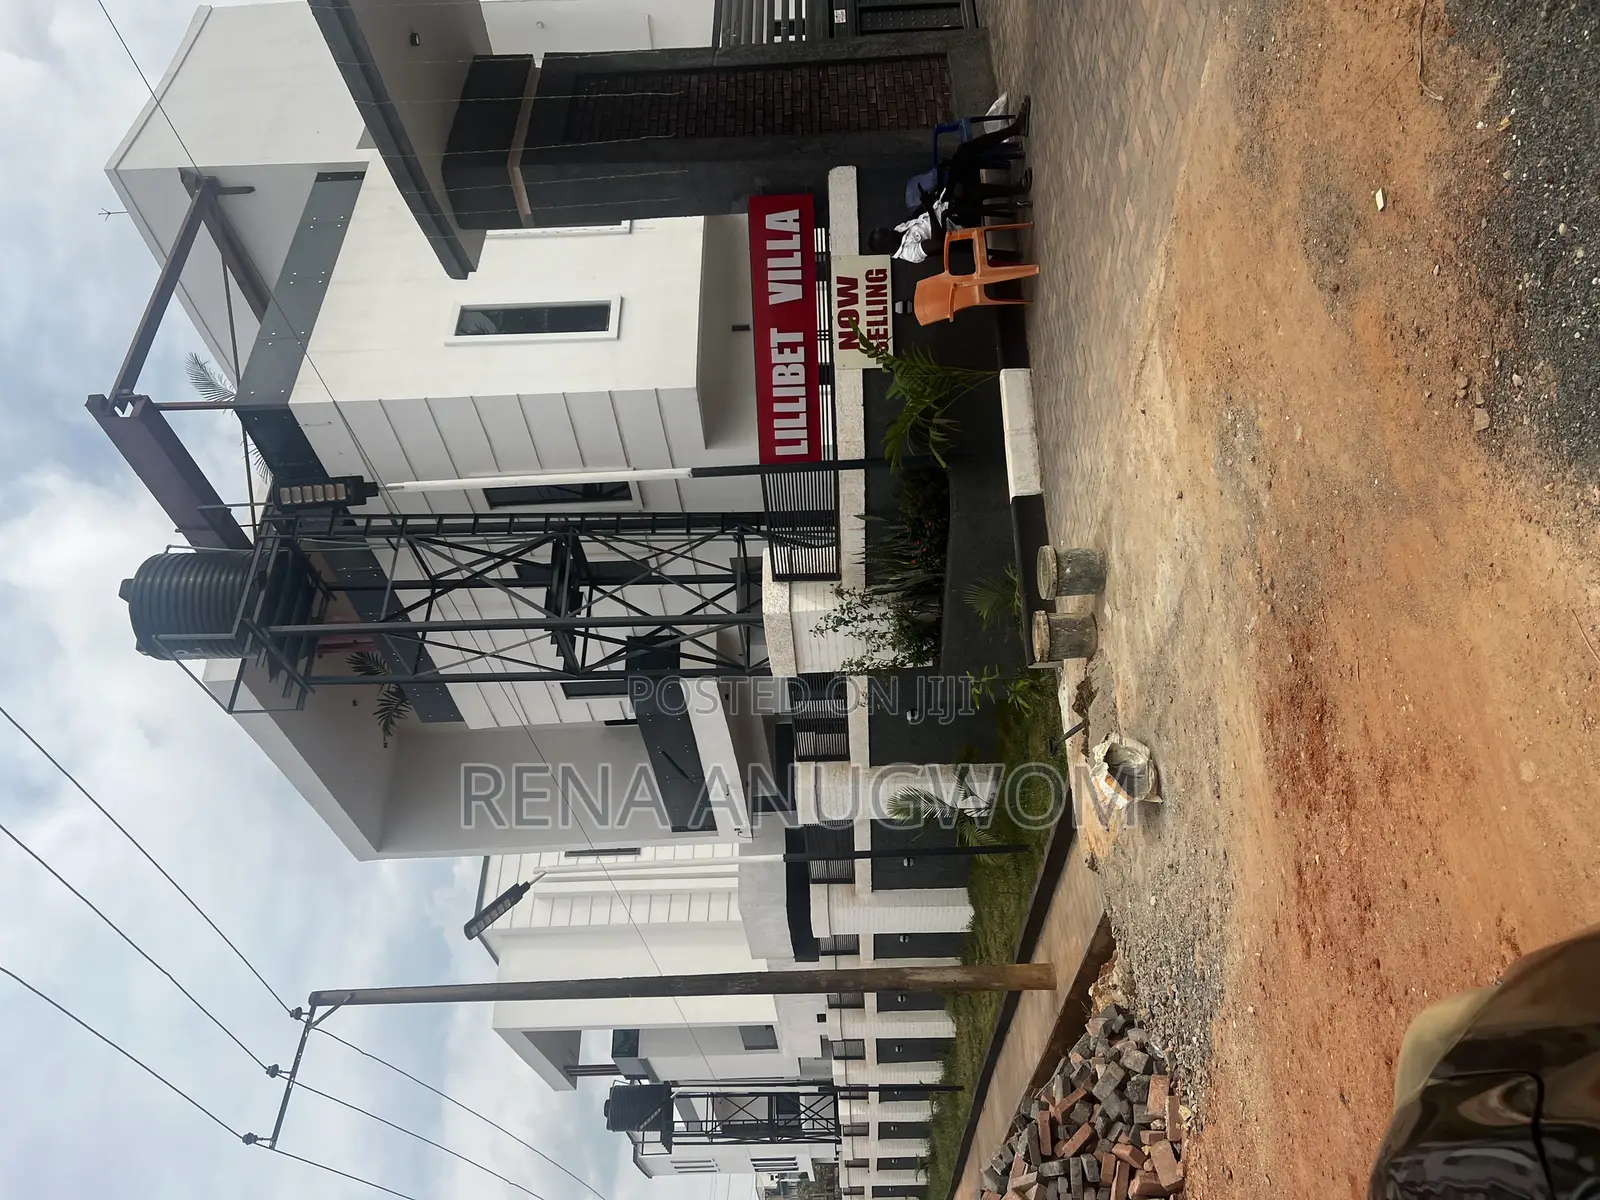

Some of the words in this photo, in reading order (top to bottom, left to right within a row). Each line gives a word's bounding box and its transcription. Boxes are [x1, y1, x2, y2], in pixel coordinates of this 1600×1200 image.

[765, 208, 803, 305] VILLA
[836, 275, 860, 350] NOW
[770, 328, 809, 456] LILLIBET
